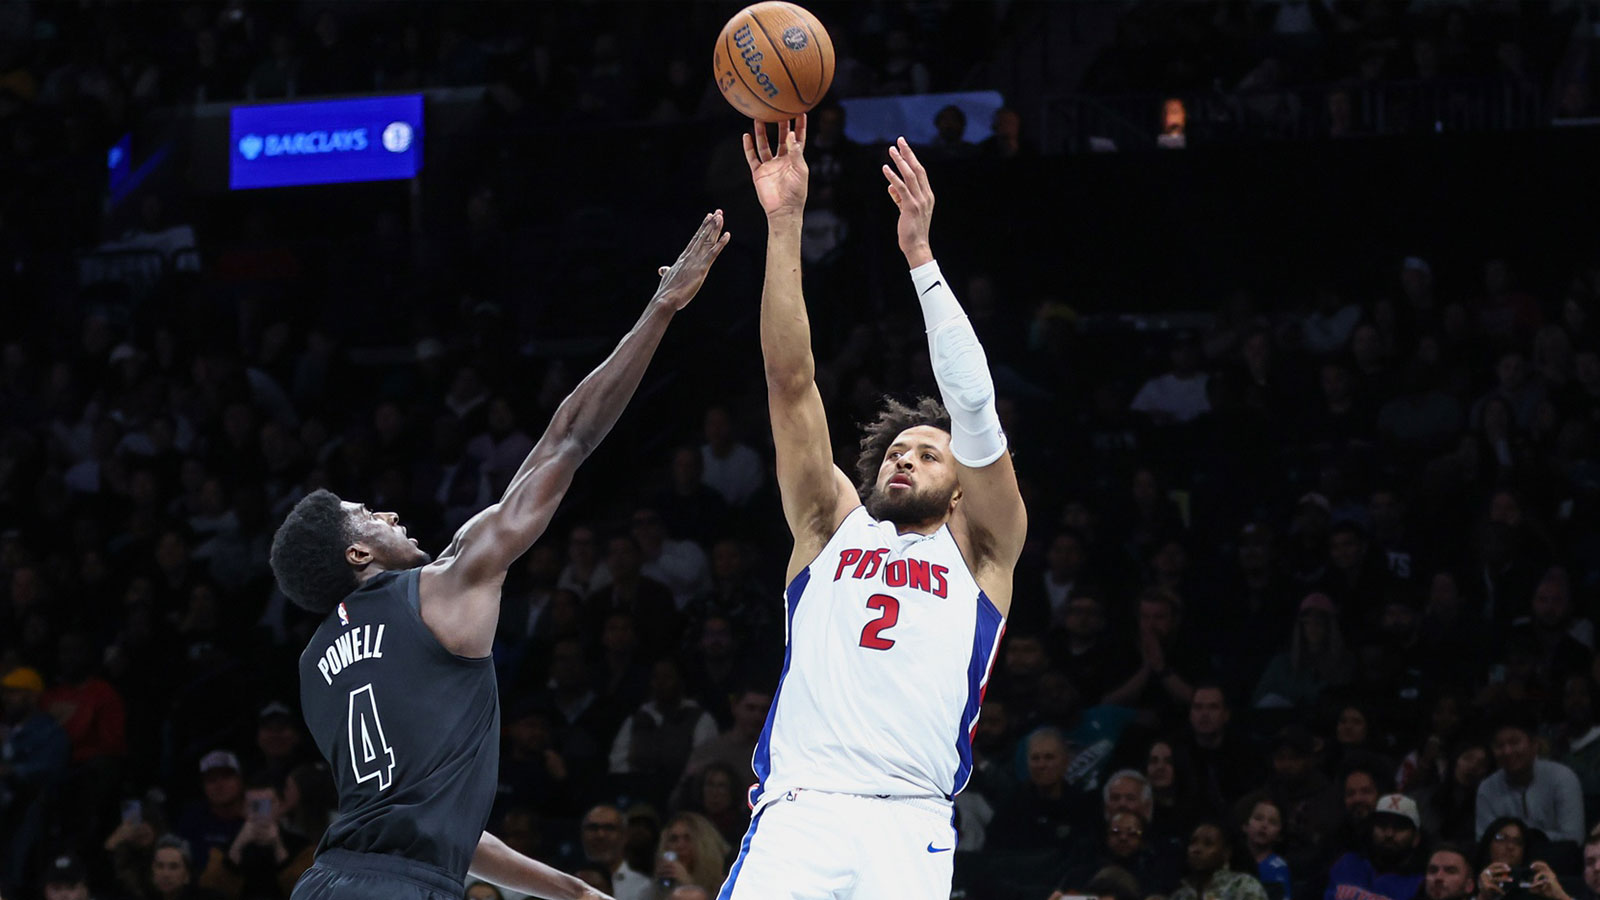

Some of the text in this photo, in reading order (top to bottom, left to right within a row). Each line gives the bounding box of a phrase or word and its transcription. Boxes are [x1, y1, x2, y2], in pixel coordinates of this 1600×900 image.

[734, 23, 779, 99] Wilson
[264, 127, 369, 157] BARCLAYS
[833, 547, 949, 600] PISONS
[858, 593, 900, 651] 2
[317, 623, 386, 686] POWELL
[347, 682, 396, 792] 4
